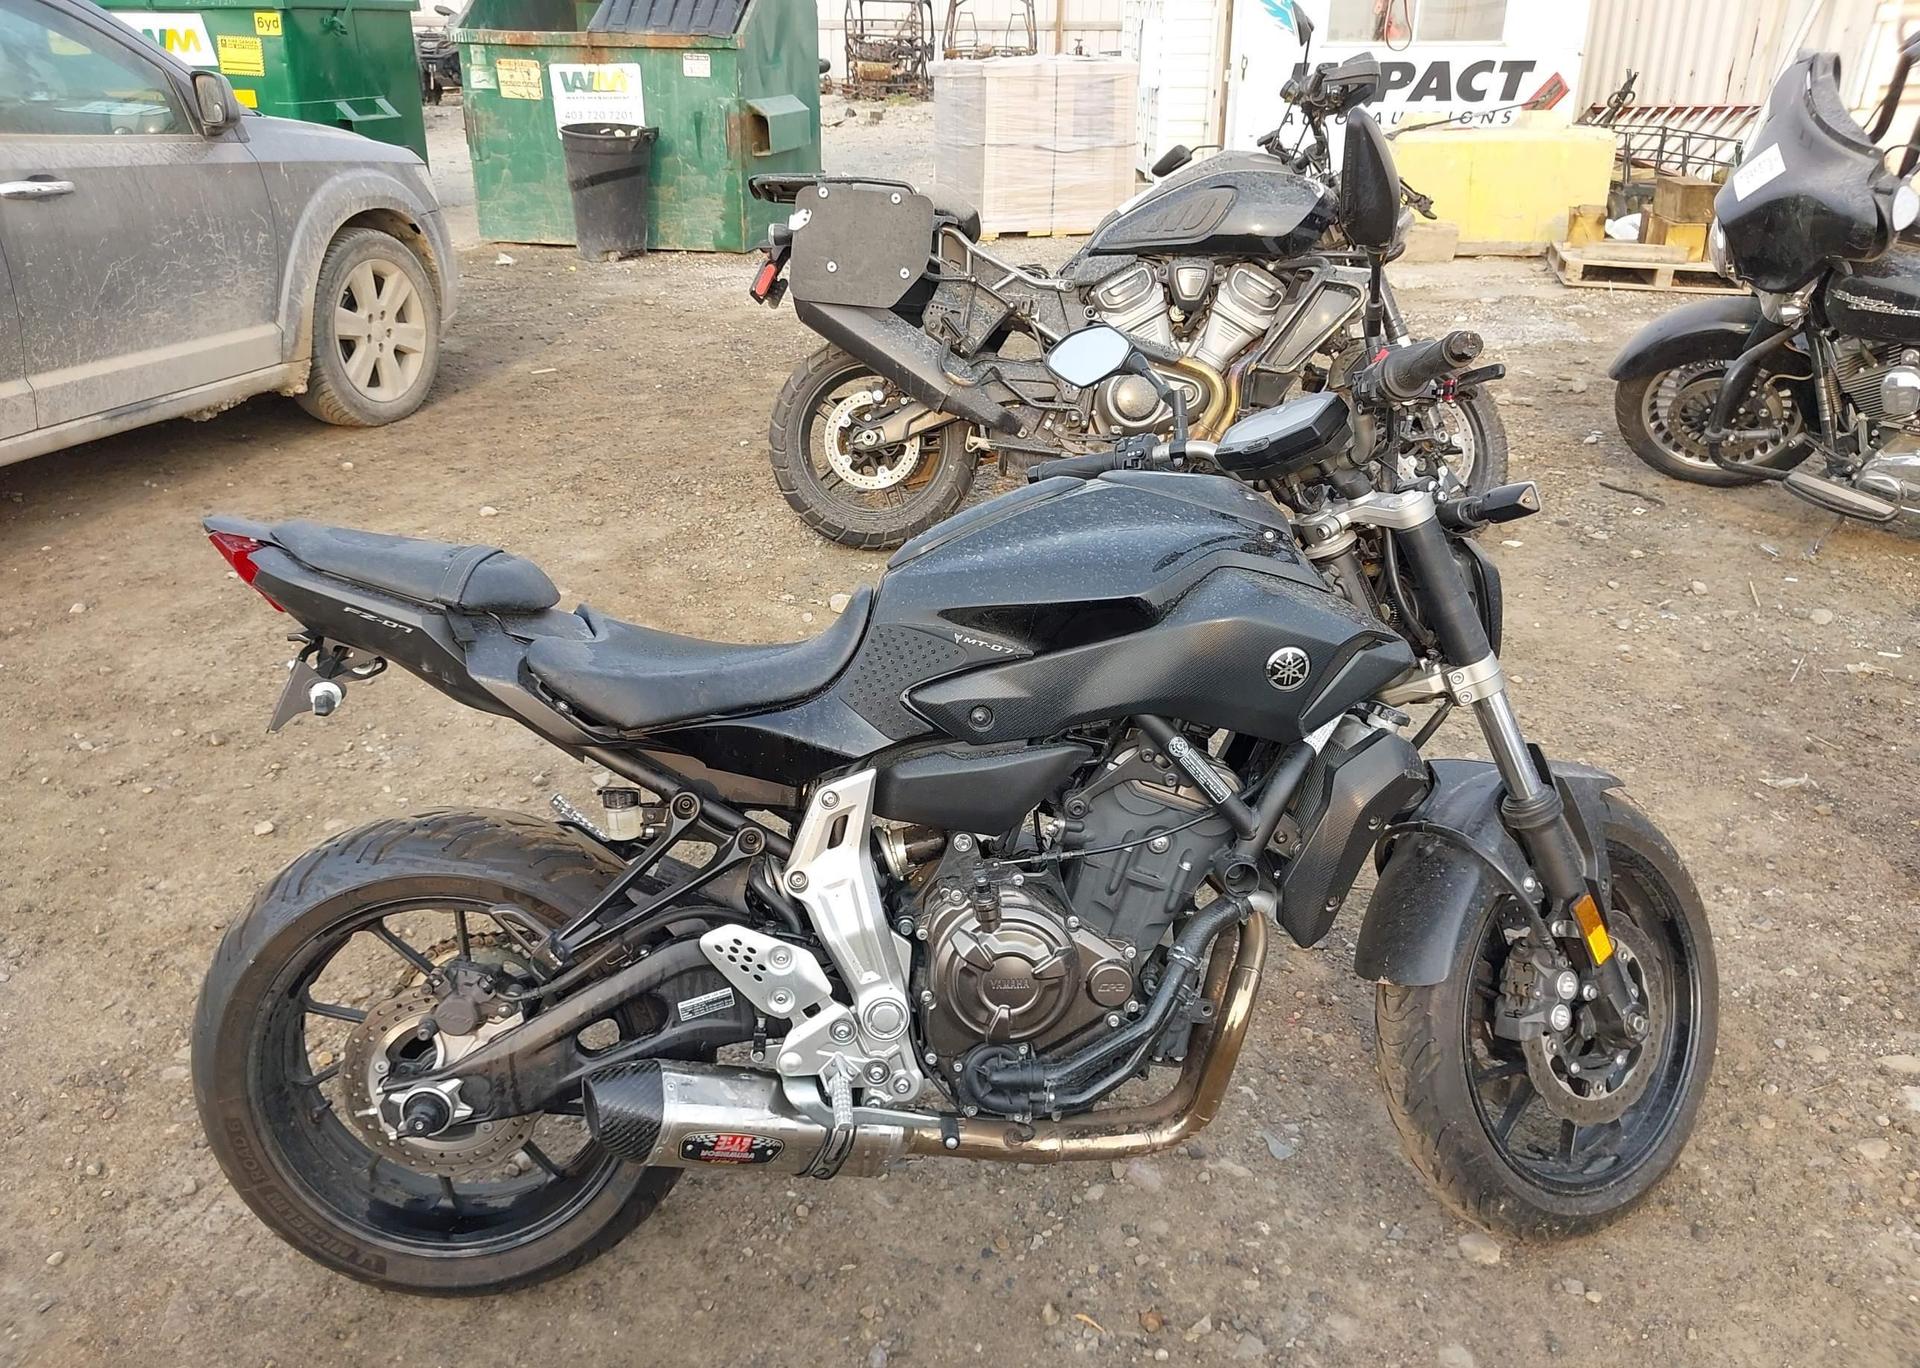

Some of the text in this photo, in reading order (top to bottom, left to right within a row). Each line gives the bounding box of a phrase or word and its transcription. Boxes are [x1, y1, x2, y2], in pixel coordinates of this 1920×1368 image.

[257, 17, 279, 31] 6yd
[559, 71, 628, 93] WM
[565, 111, 633, 120] 403 720 7201
[963, 637, 1014, 654] MT-07
[990, 978, 1030, 990] YAMAHA
